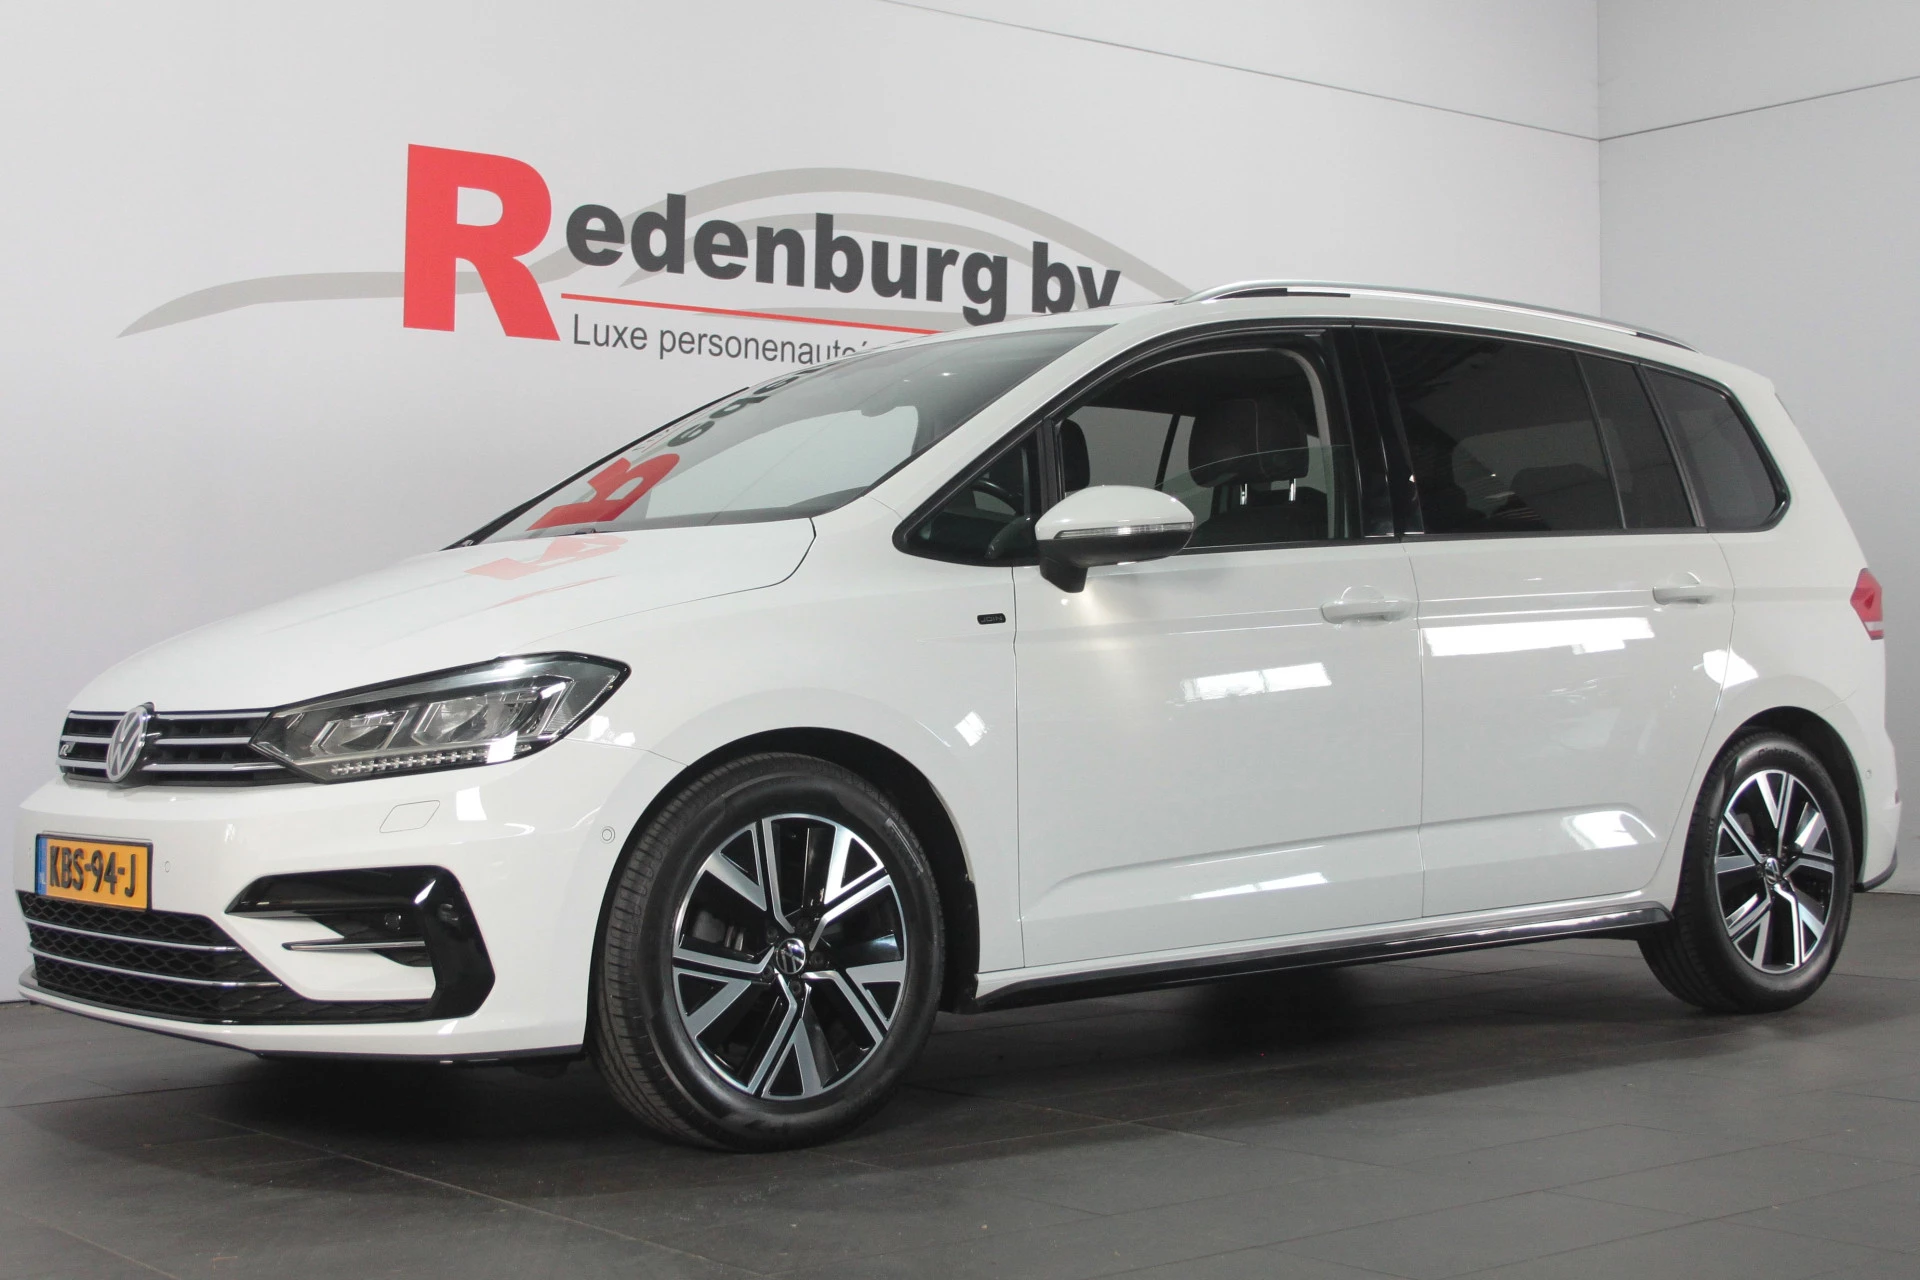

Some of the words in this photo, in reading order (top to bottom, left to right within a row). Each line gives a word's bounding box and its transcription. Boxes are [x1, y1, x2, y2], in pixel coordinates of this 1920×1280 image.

[403, 143, 1008, 341] Redenburg
[1031, 240, 1122, 313] bv
[573, 313, 648, 350] Luxe
[49, 845, 137, 898] KBS-94-J
